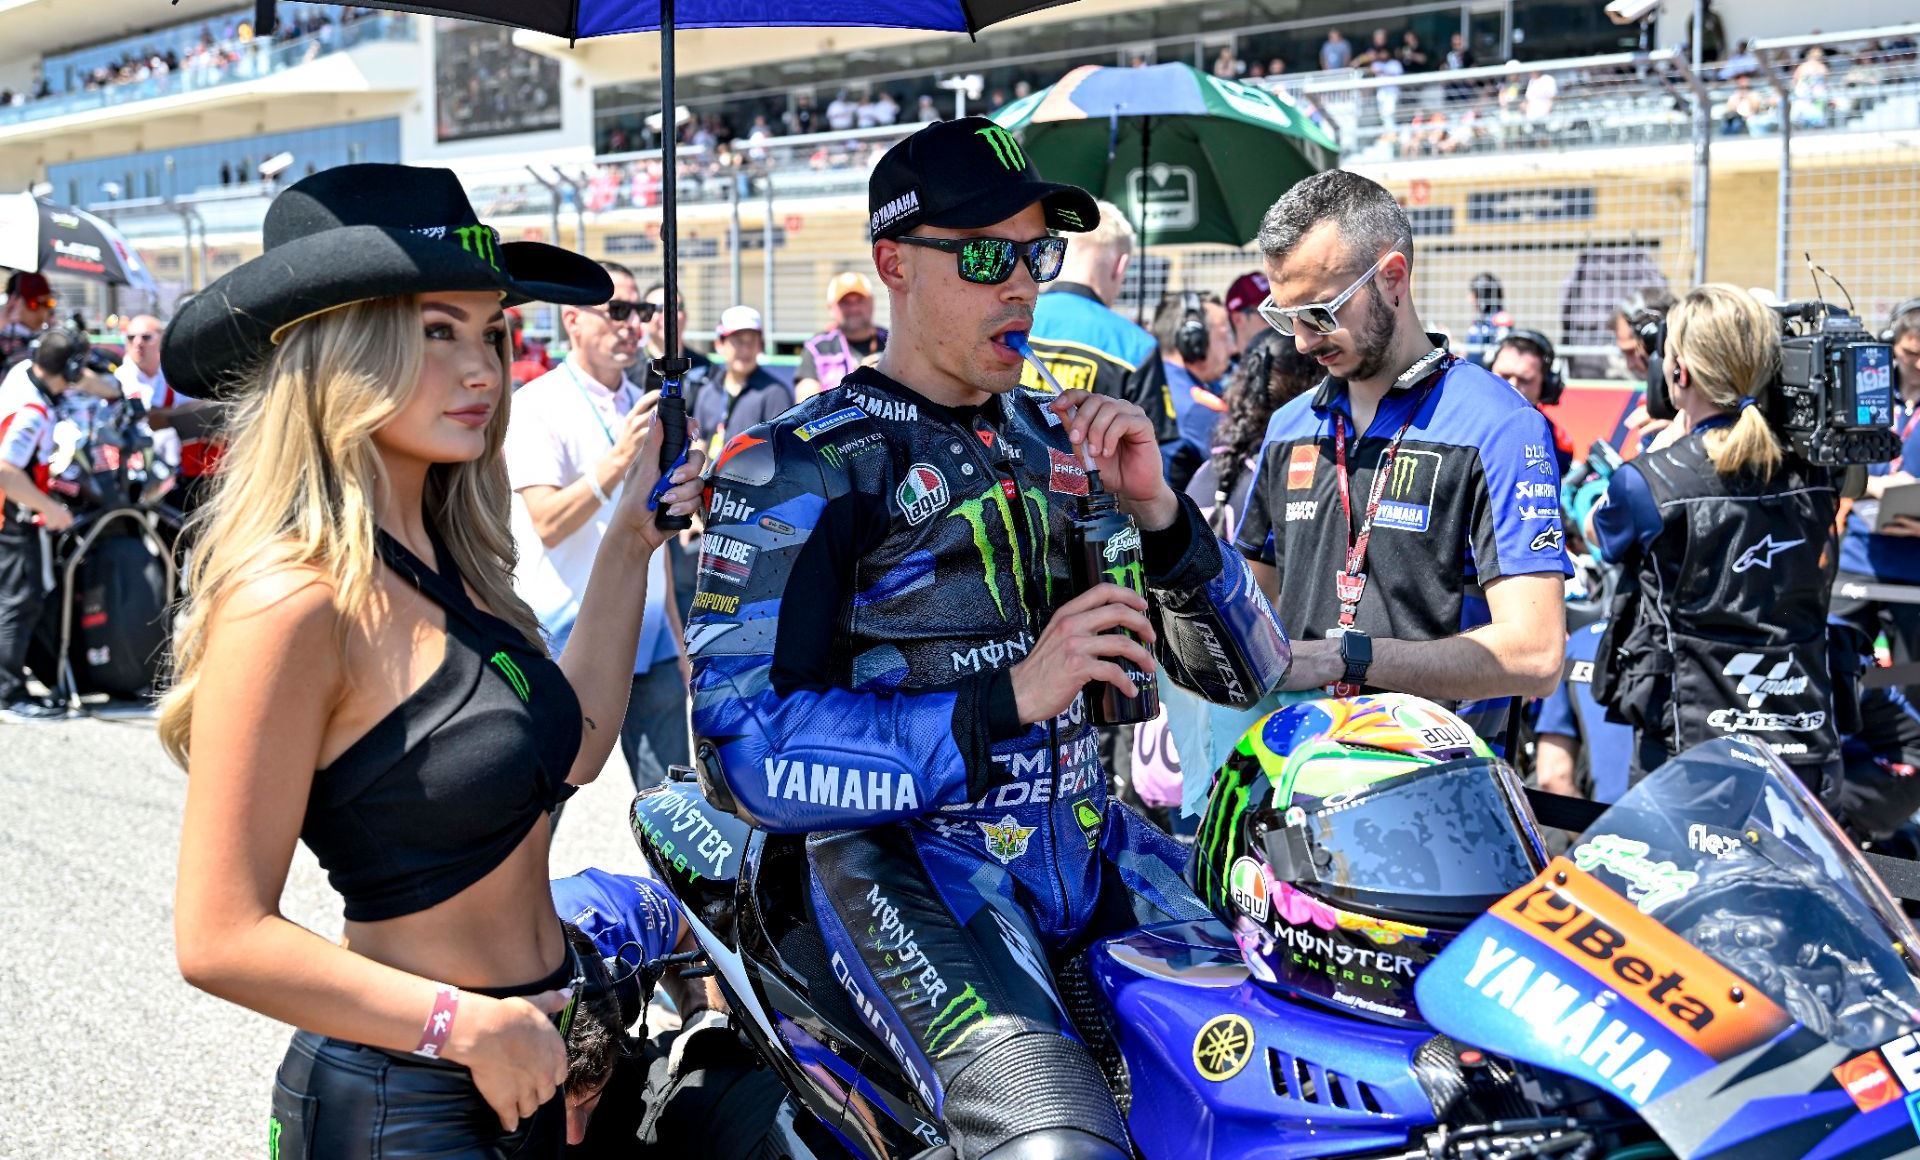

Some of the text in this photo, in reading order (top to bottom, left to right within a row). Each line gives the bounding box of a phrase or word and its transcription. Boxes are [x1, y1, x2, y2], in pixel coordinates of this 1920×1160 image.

[879, 190, 918, 223] YAMAHA
[818, 411, 857, 429] MICHELIN
[846, 388, 918, 421] YAMAHA
[837, 433, 885, 454] MONSTER
[912, 488, 943, 518] agv
[1381, 505, 1423, 524] YAMAHA
[950, 631, 1036, 672] MON
[1421, 726, 1463, 746] agv
[765, 758, 919, 811] YAMAHA
[637, 810, 702, 884] ENERGY
[647, 788, 733, 878] MONSTER
[867, 884, 948, 1008] MONSTER
[1274, 921, 1415, 978] MONSTER
[1292, 952, 1391, 988] ENERGY
[1565, 911, 1715, 1032] Beta
[832, 950, 936, 1112] DAINESE
[1463, 936, 1672, 1105] YAMAHA
[912, 1117, 947, 1147] Re
